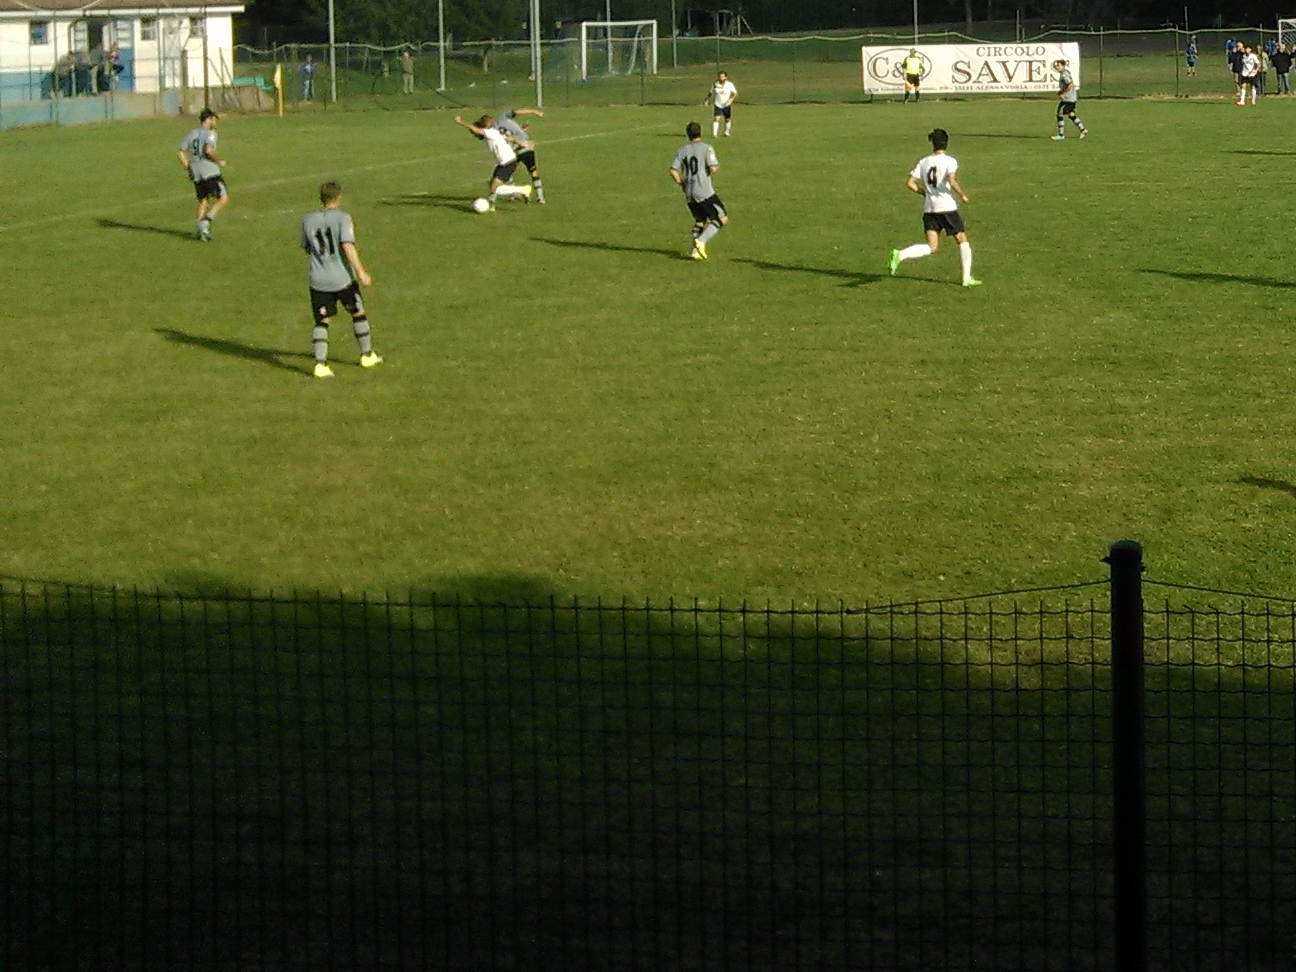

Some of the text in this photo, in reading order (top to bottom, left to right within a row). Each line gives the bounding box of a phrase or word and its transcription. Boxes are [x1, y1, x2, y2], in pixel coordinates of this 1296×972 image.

[976, 45, 1046, 58] CIRCOLO
[683, 156, 698, 176] 10
[315, 226, 335, 255] 11
